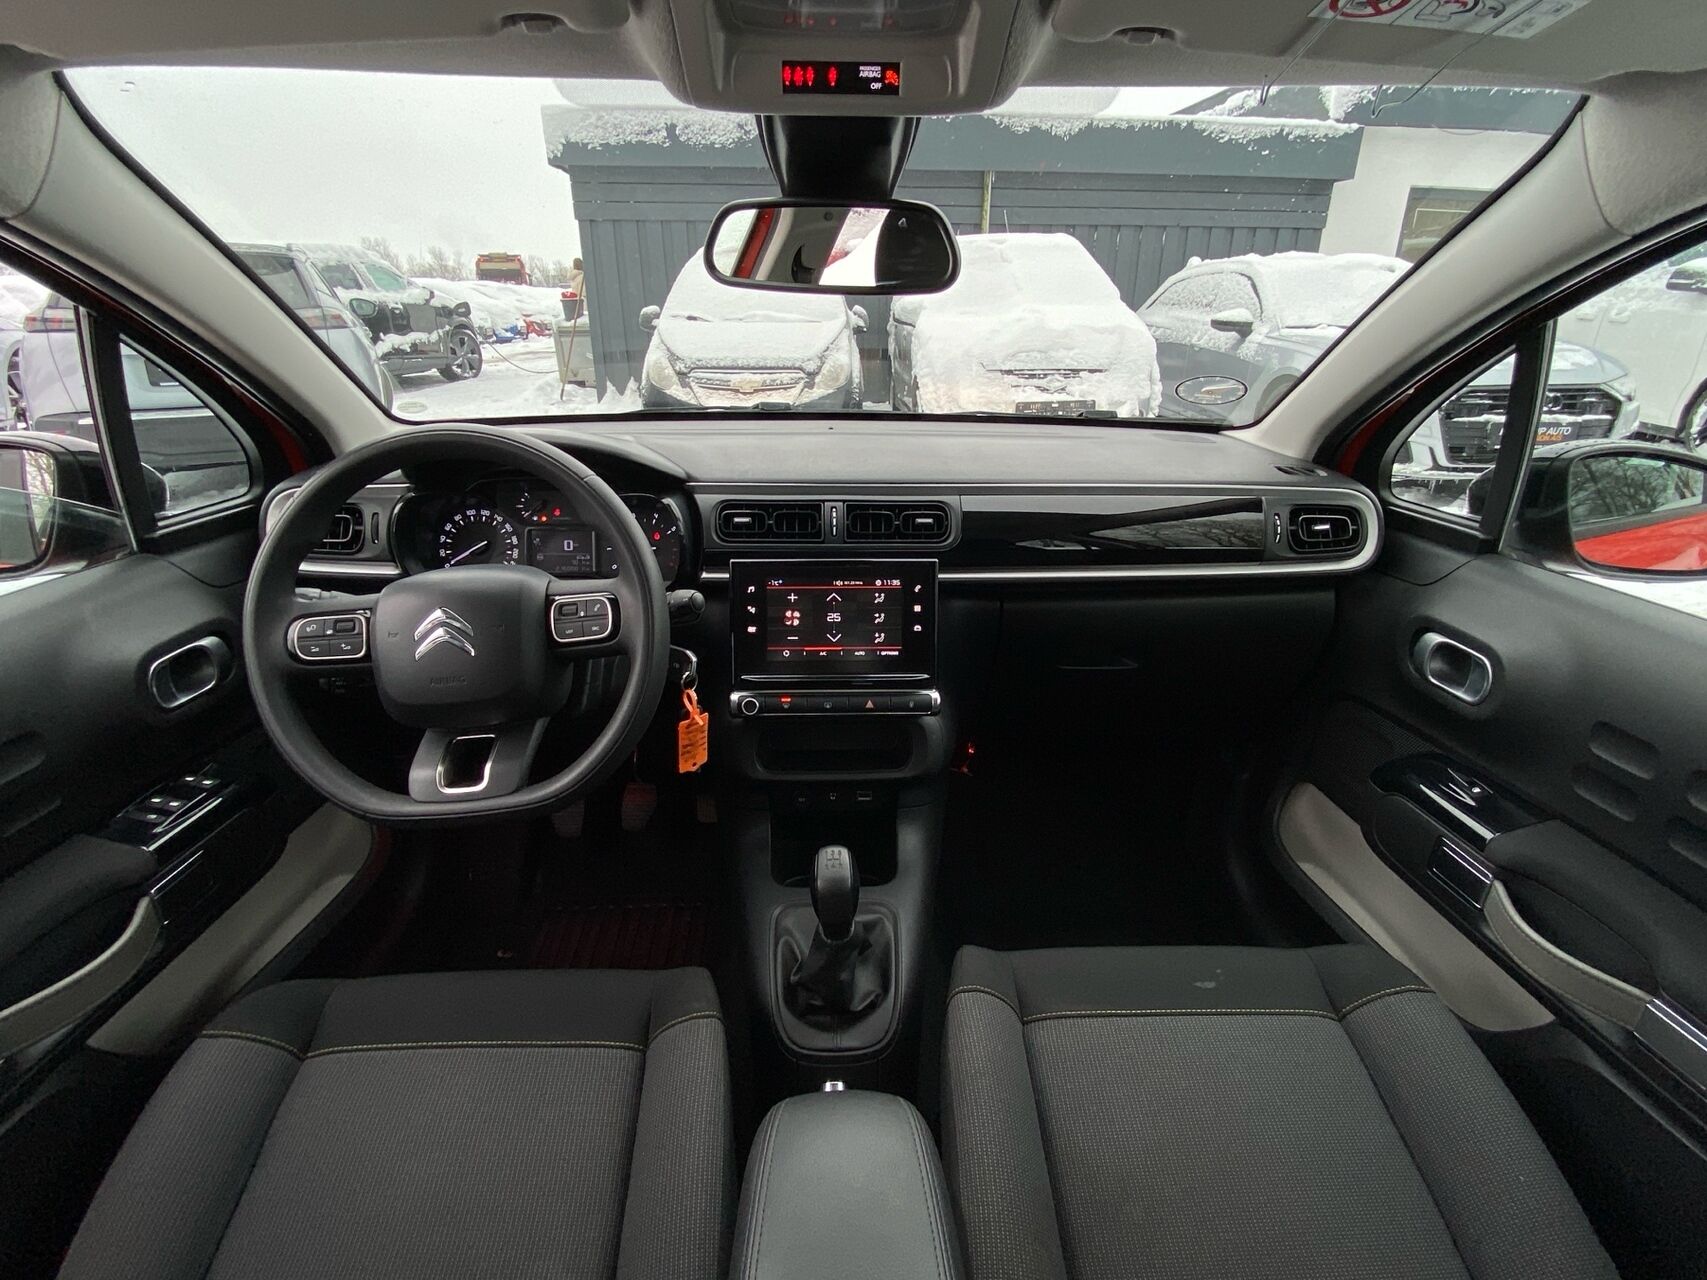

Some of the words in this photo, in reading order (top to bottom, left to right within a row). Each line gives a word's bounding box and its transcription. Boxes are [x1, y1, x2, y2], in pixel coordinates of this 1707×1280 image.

[859, 70, 881, 78] AIRBAG
[870, 82, 882, 90] OFF
[1546, 426, 1572, 435] AUTO
[563, 539, 574, 551] 0
[826, 612, 841, 622] 25
